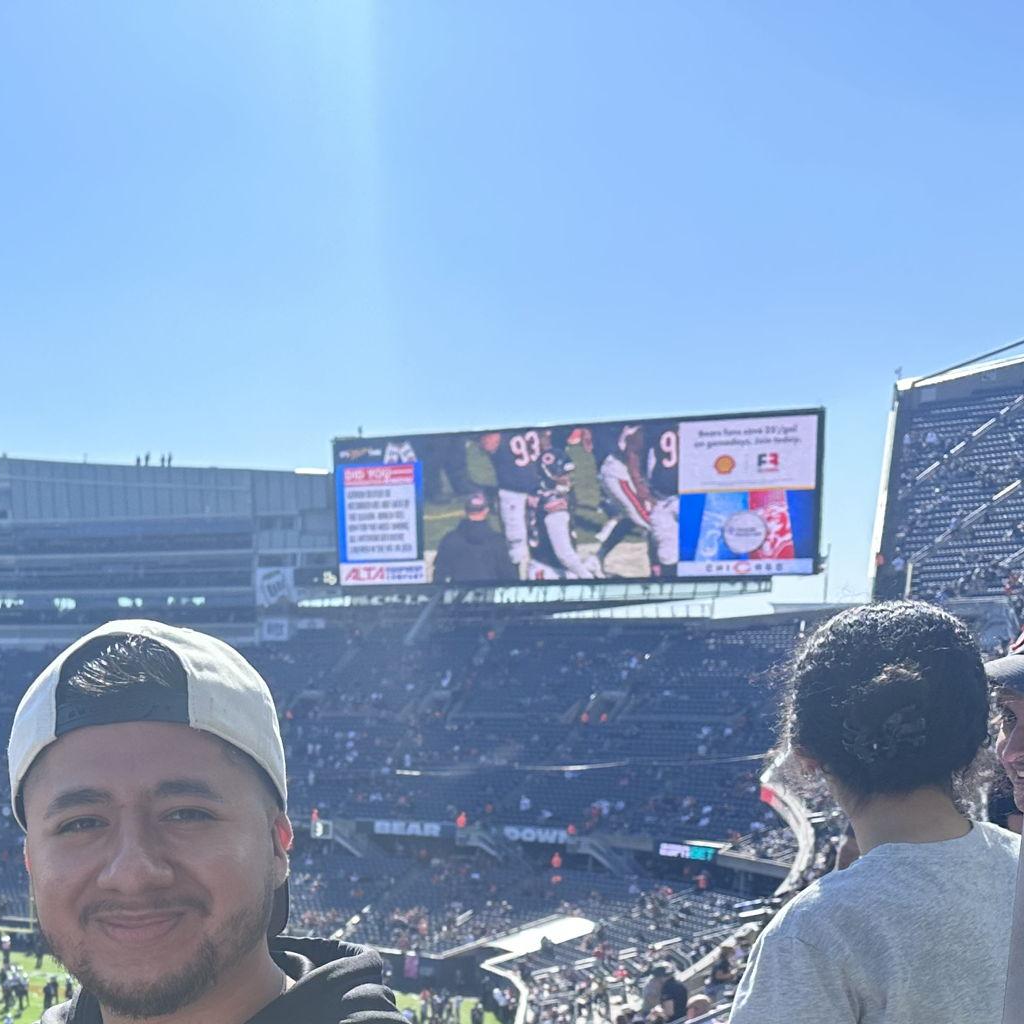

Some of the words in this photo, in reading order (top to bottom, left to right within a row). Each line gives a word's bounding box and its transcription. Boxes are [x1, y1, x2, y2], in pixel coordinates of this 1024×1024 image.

[509, 430, 541, 467] 93
[345, 566, 385, 581] ALTA
[374, 820, 441, 837] BEAR
